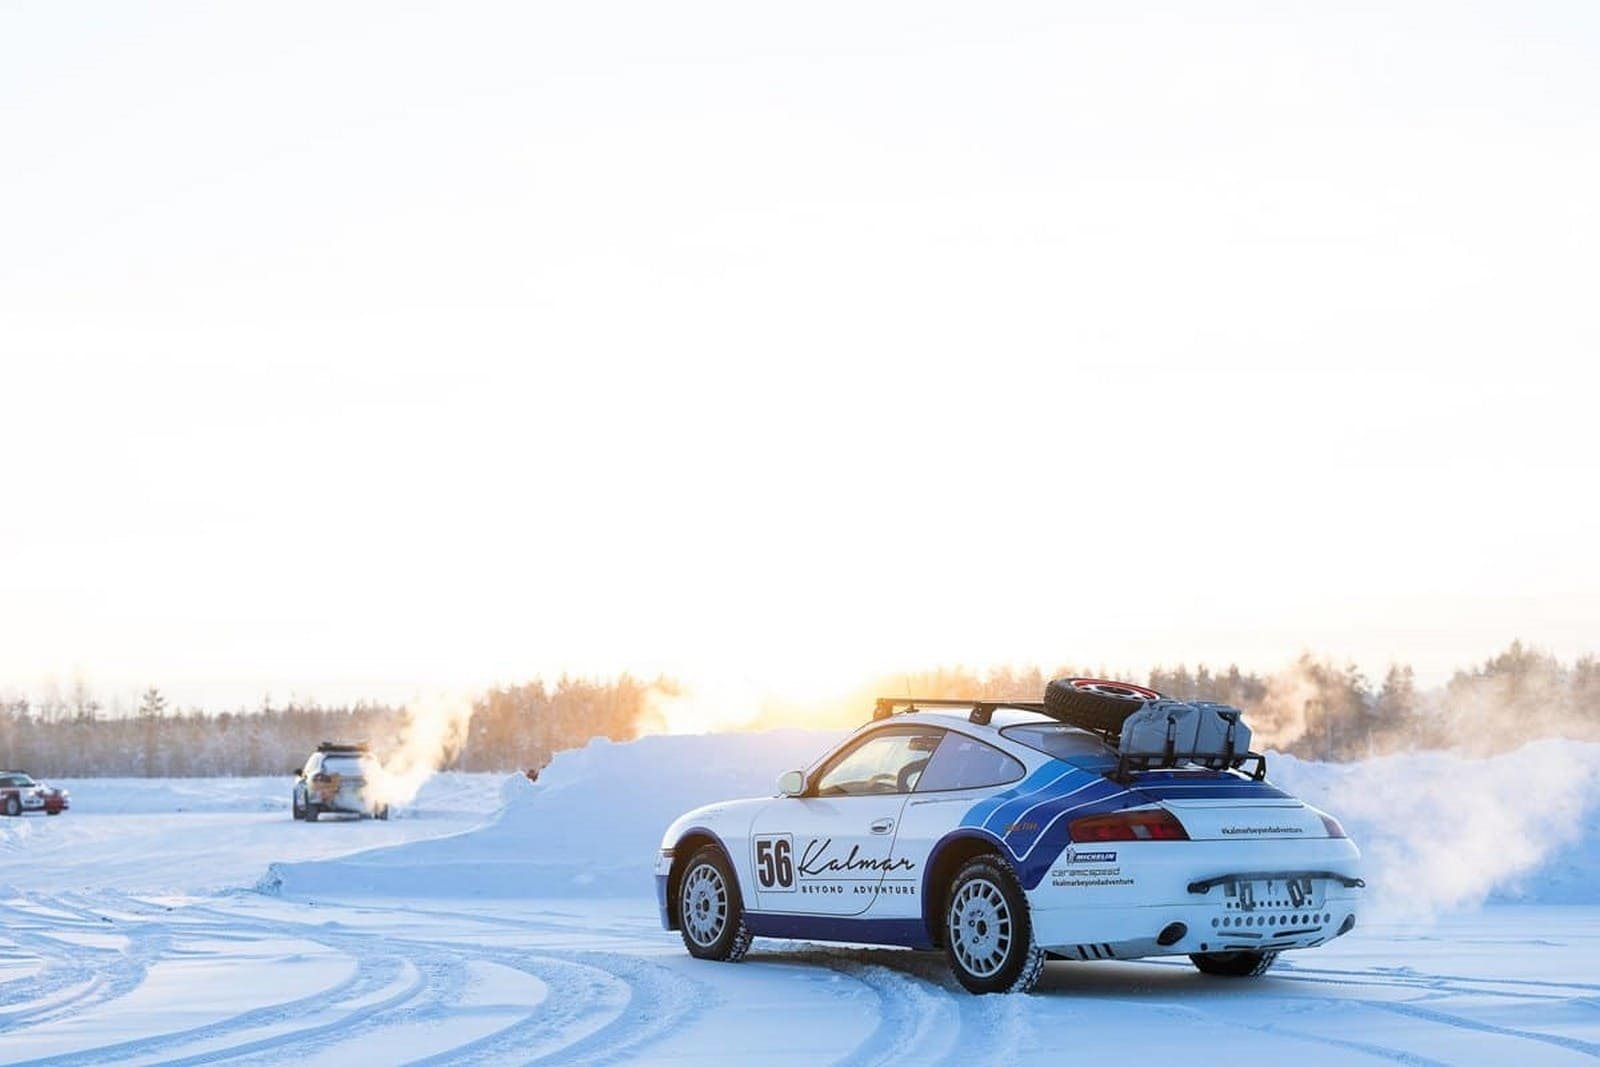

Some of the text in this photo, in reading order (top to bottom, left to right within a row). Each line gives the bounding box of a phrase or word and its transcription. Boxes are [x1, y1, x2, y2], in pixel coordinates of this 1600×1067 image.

[757, 839, 793, 888] 56
[797, 838, 916, 877] Kalmar
[1076, 853, 1115, 861] MICHELIN
[802, 885, 916, 895] BEYOND ADVENTURE
